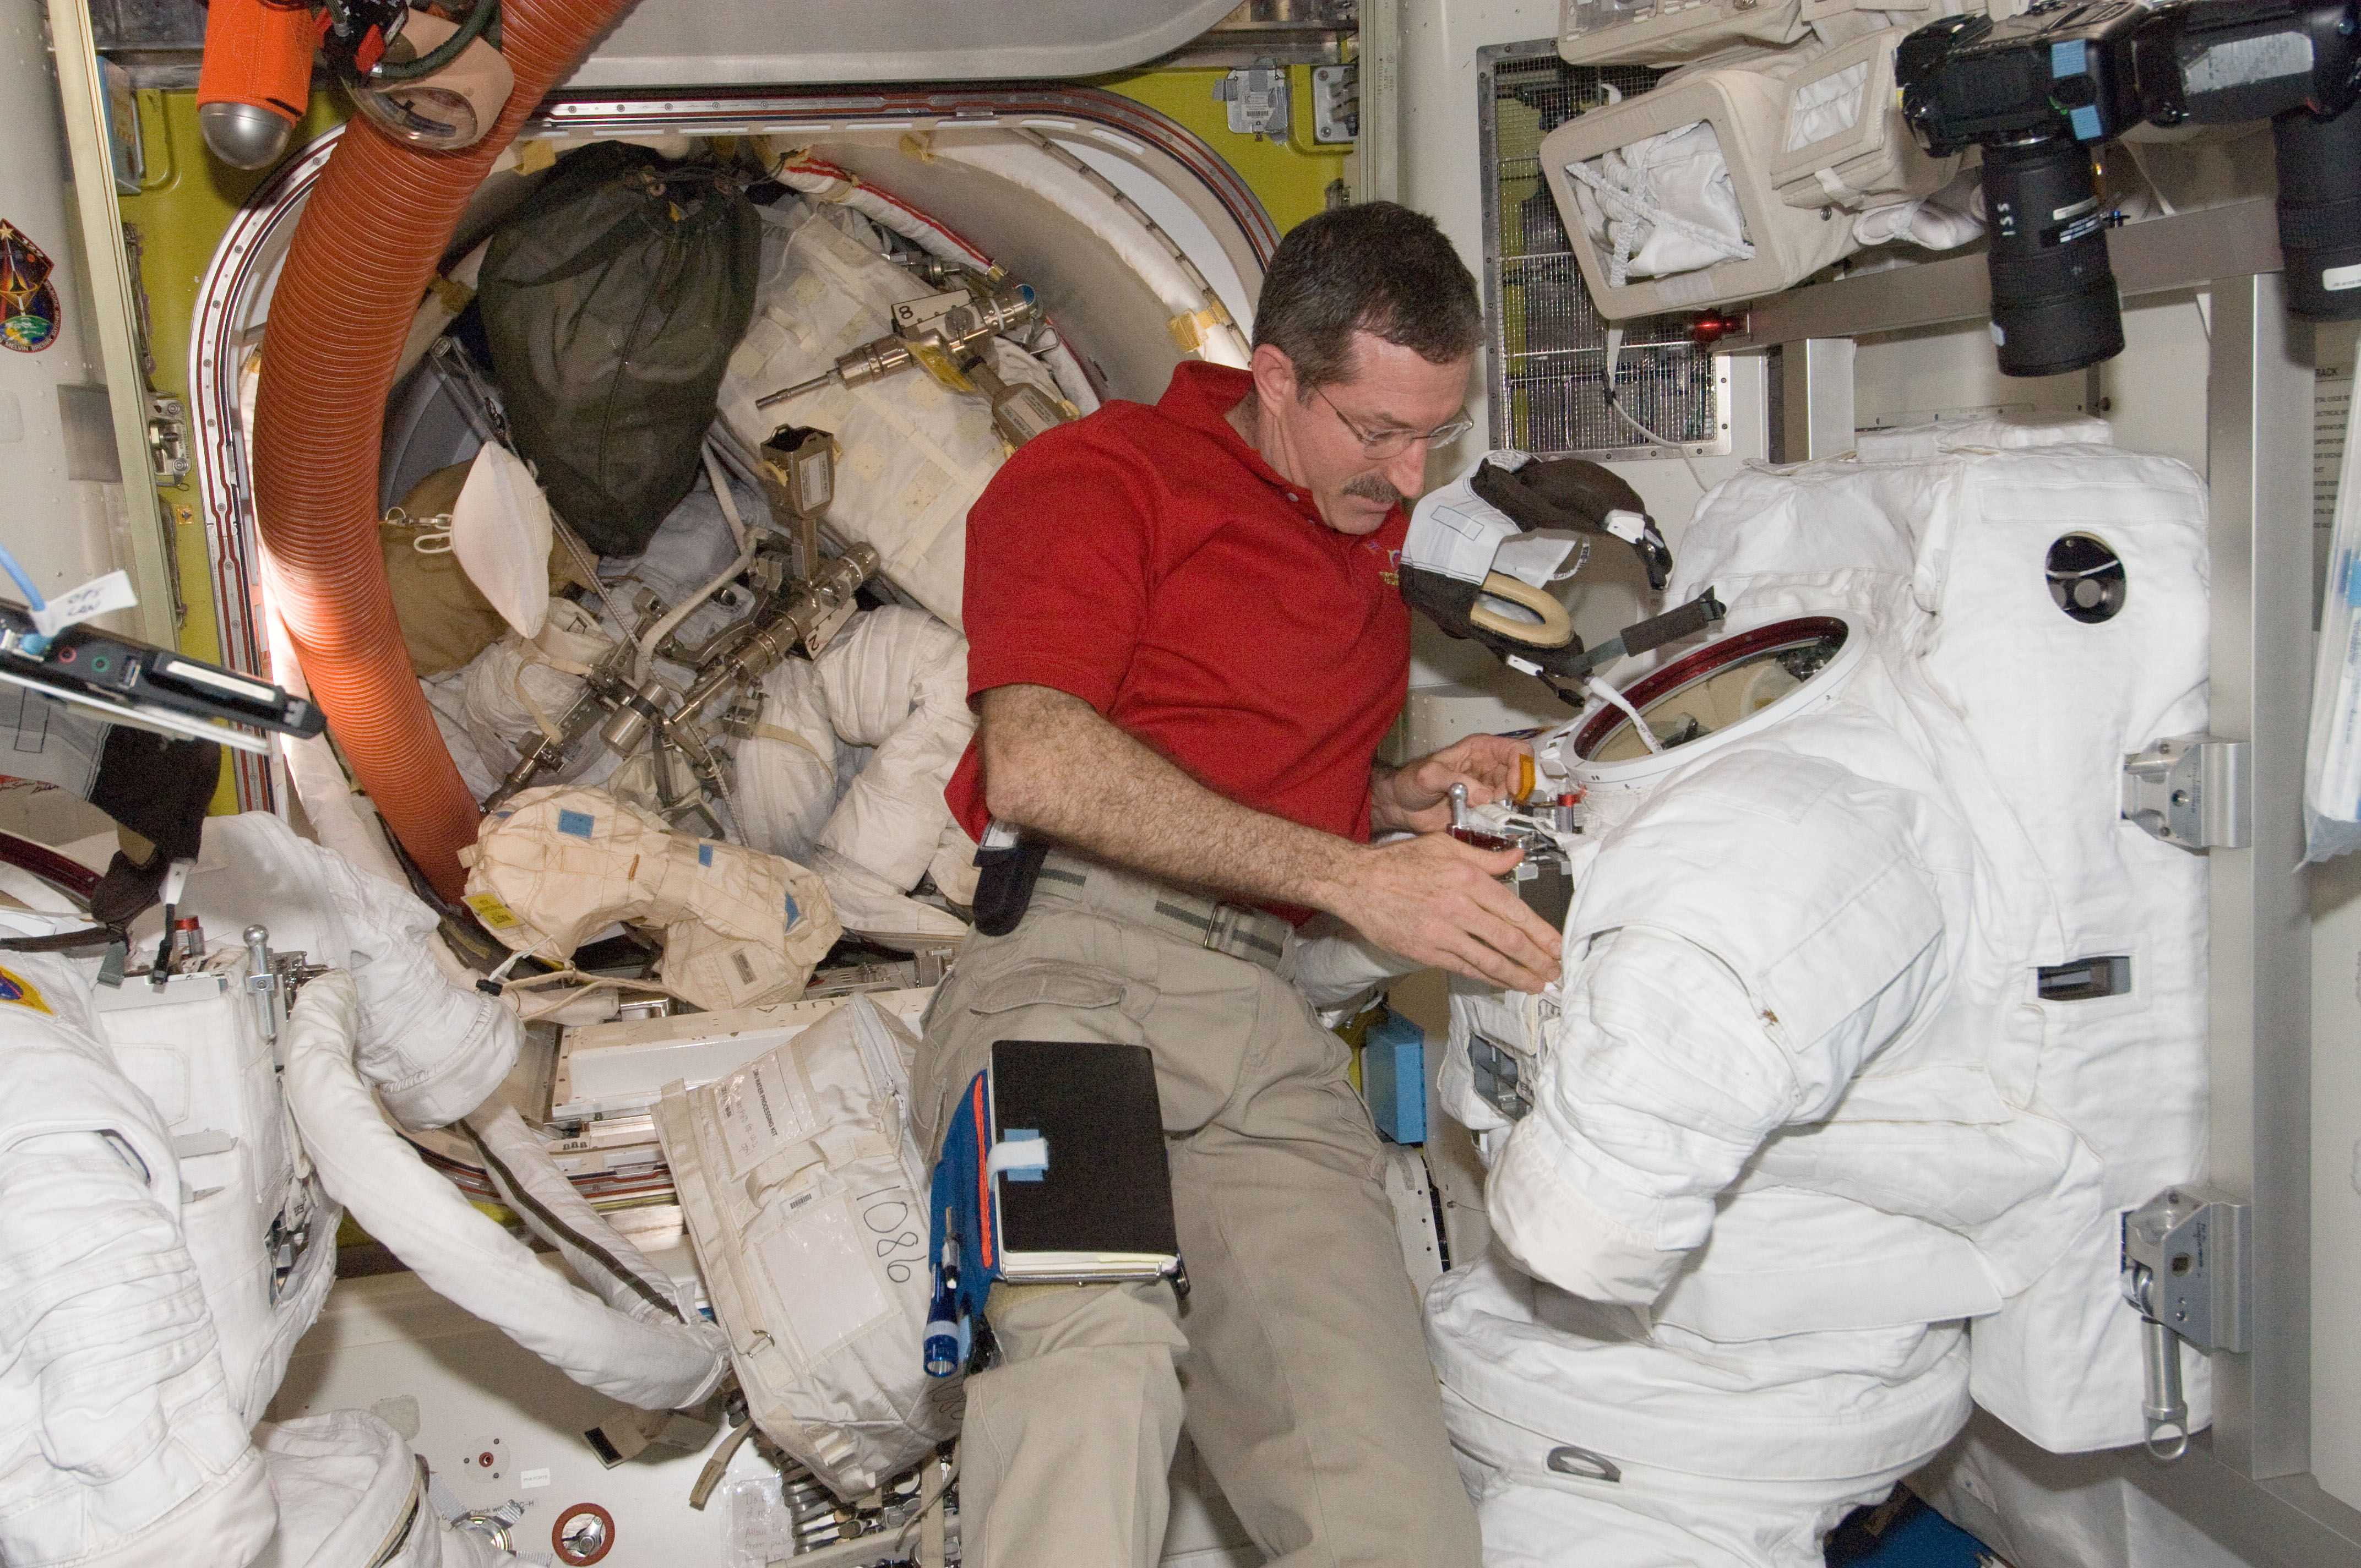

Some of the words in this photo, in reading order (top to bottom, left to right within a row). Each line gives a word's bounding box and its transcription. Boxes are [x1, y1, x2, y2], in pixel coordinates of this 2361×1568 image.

[1997, 203, 2016, 236] ISS
[899, 306, 913, 319] 8
[5, 341, 29, 351] MELVIN
[31, 336, 53, 351] BRESNIK
[808, 634, 819, 651] 2
[755, 1079, 764, 1096] WATER
[759, 1093, 774, 1128] PROCESSING
[856, 1185, 927, 1283] 1086
